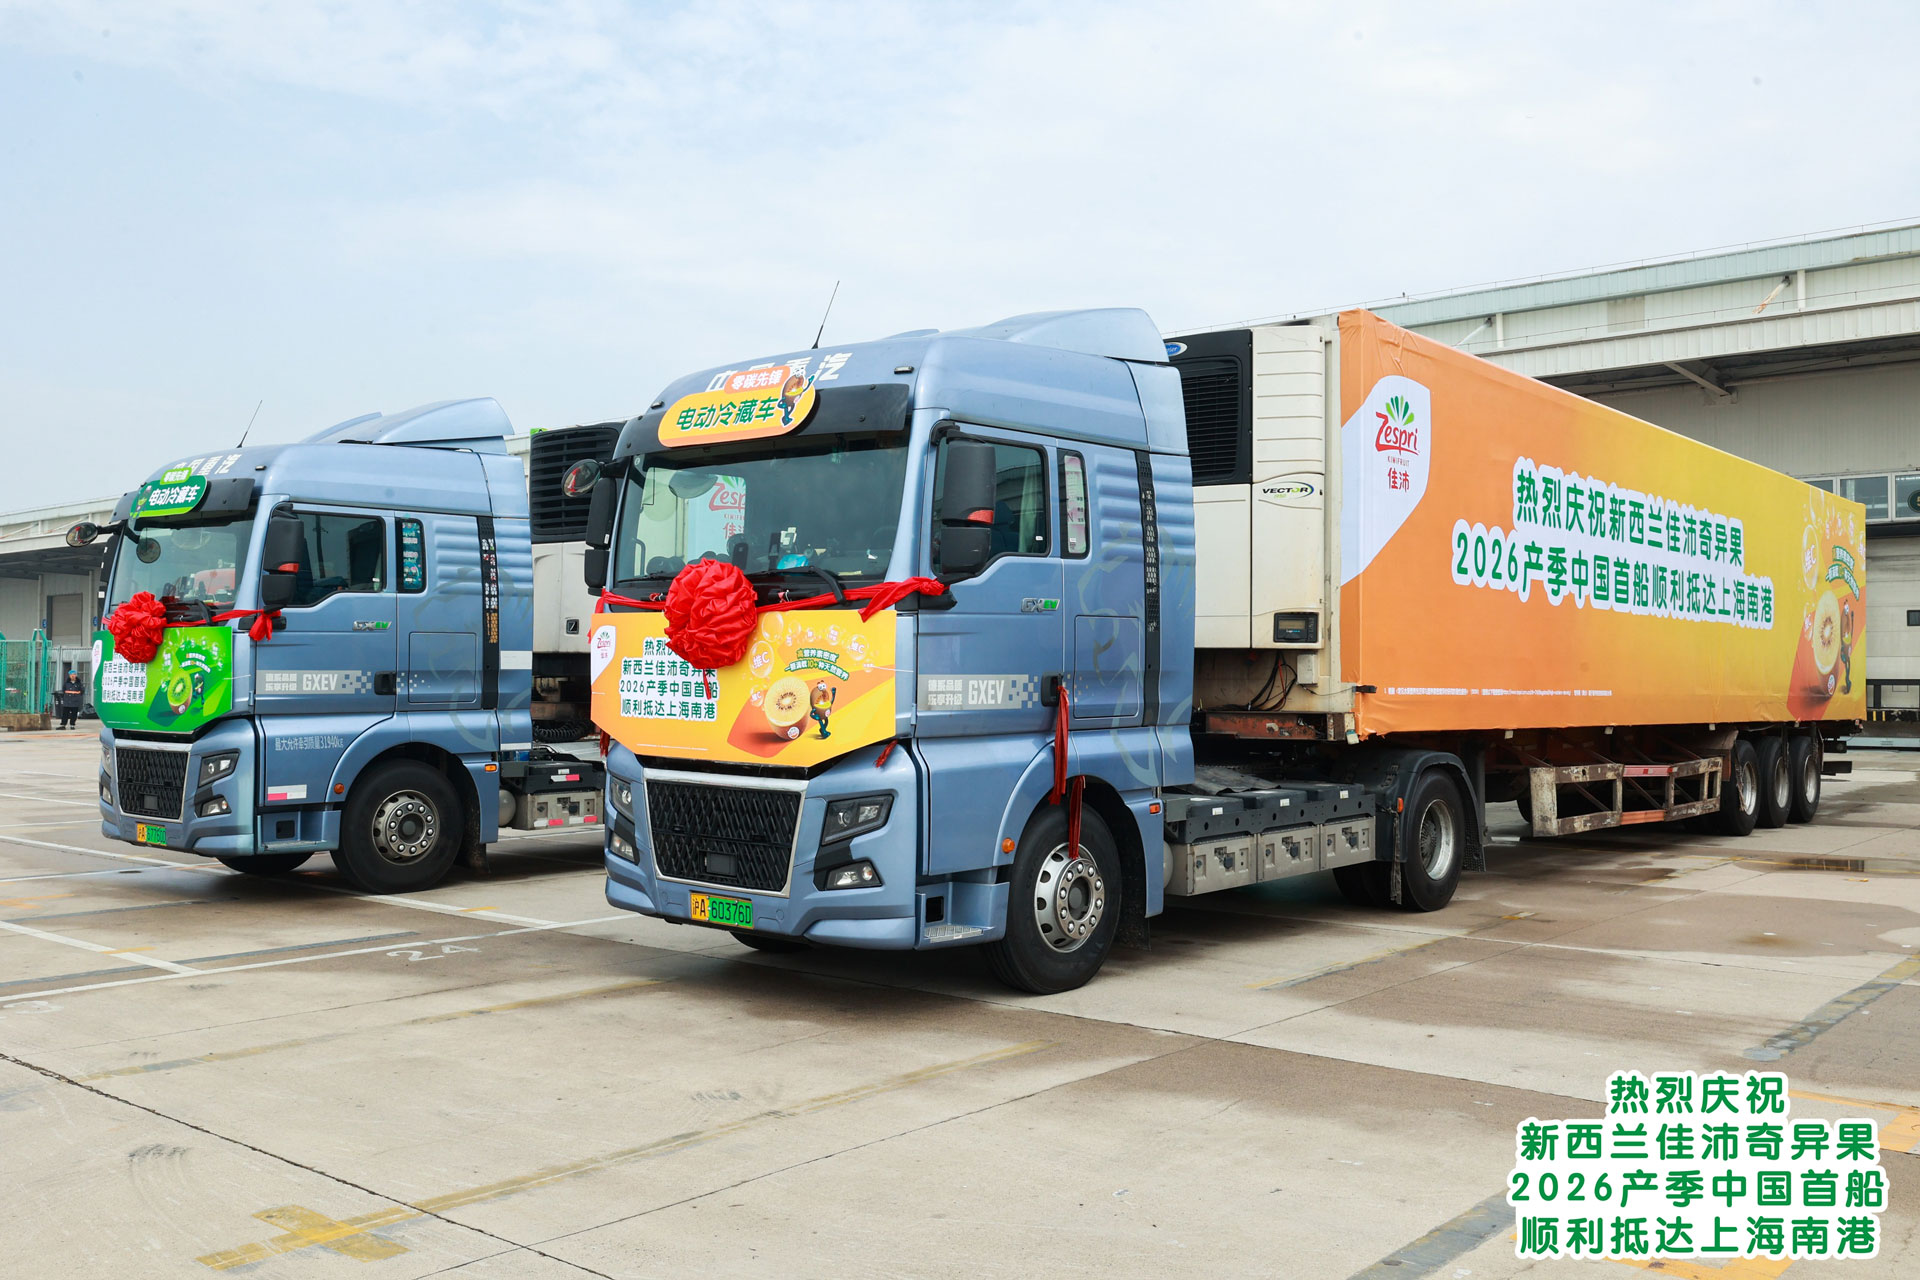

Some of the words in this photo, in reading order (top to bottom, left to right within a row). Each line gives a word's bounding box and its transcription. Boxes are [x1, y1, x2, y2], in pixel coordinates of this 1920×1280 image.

[731, 369, 784, 391] 零碳先锋
[676, 396, 779, 430] 电动冷藏车
[1375, 411, 1420, 455] Zespri
[1388, 467, 1410, 493] 佳沛
[149, 484, 200, 506] 电动冷藏车
[708, 482, 746, 512] Zesp
[1517, 469, 1742, 567] 热烈庆祝新西兰佳沛奇异果
[1457, 532, 1772, 623] 2026产季中国首船顺利抵达上海南港
[644, 640, 679, 656] 热烈
[302, 674, 338, 691] GXEV
[968, 679, 1005, 705] GXEV
[621, 699, 716, 719] 顺利抵达上海南港
